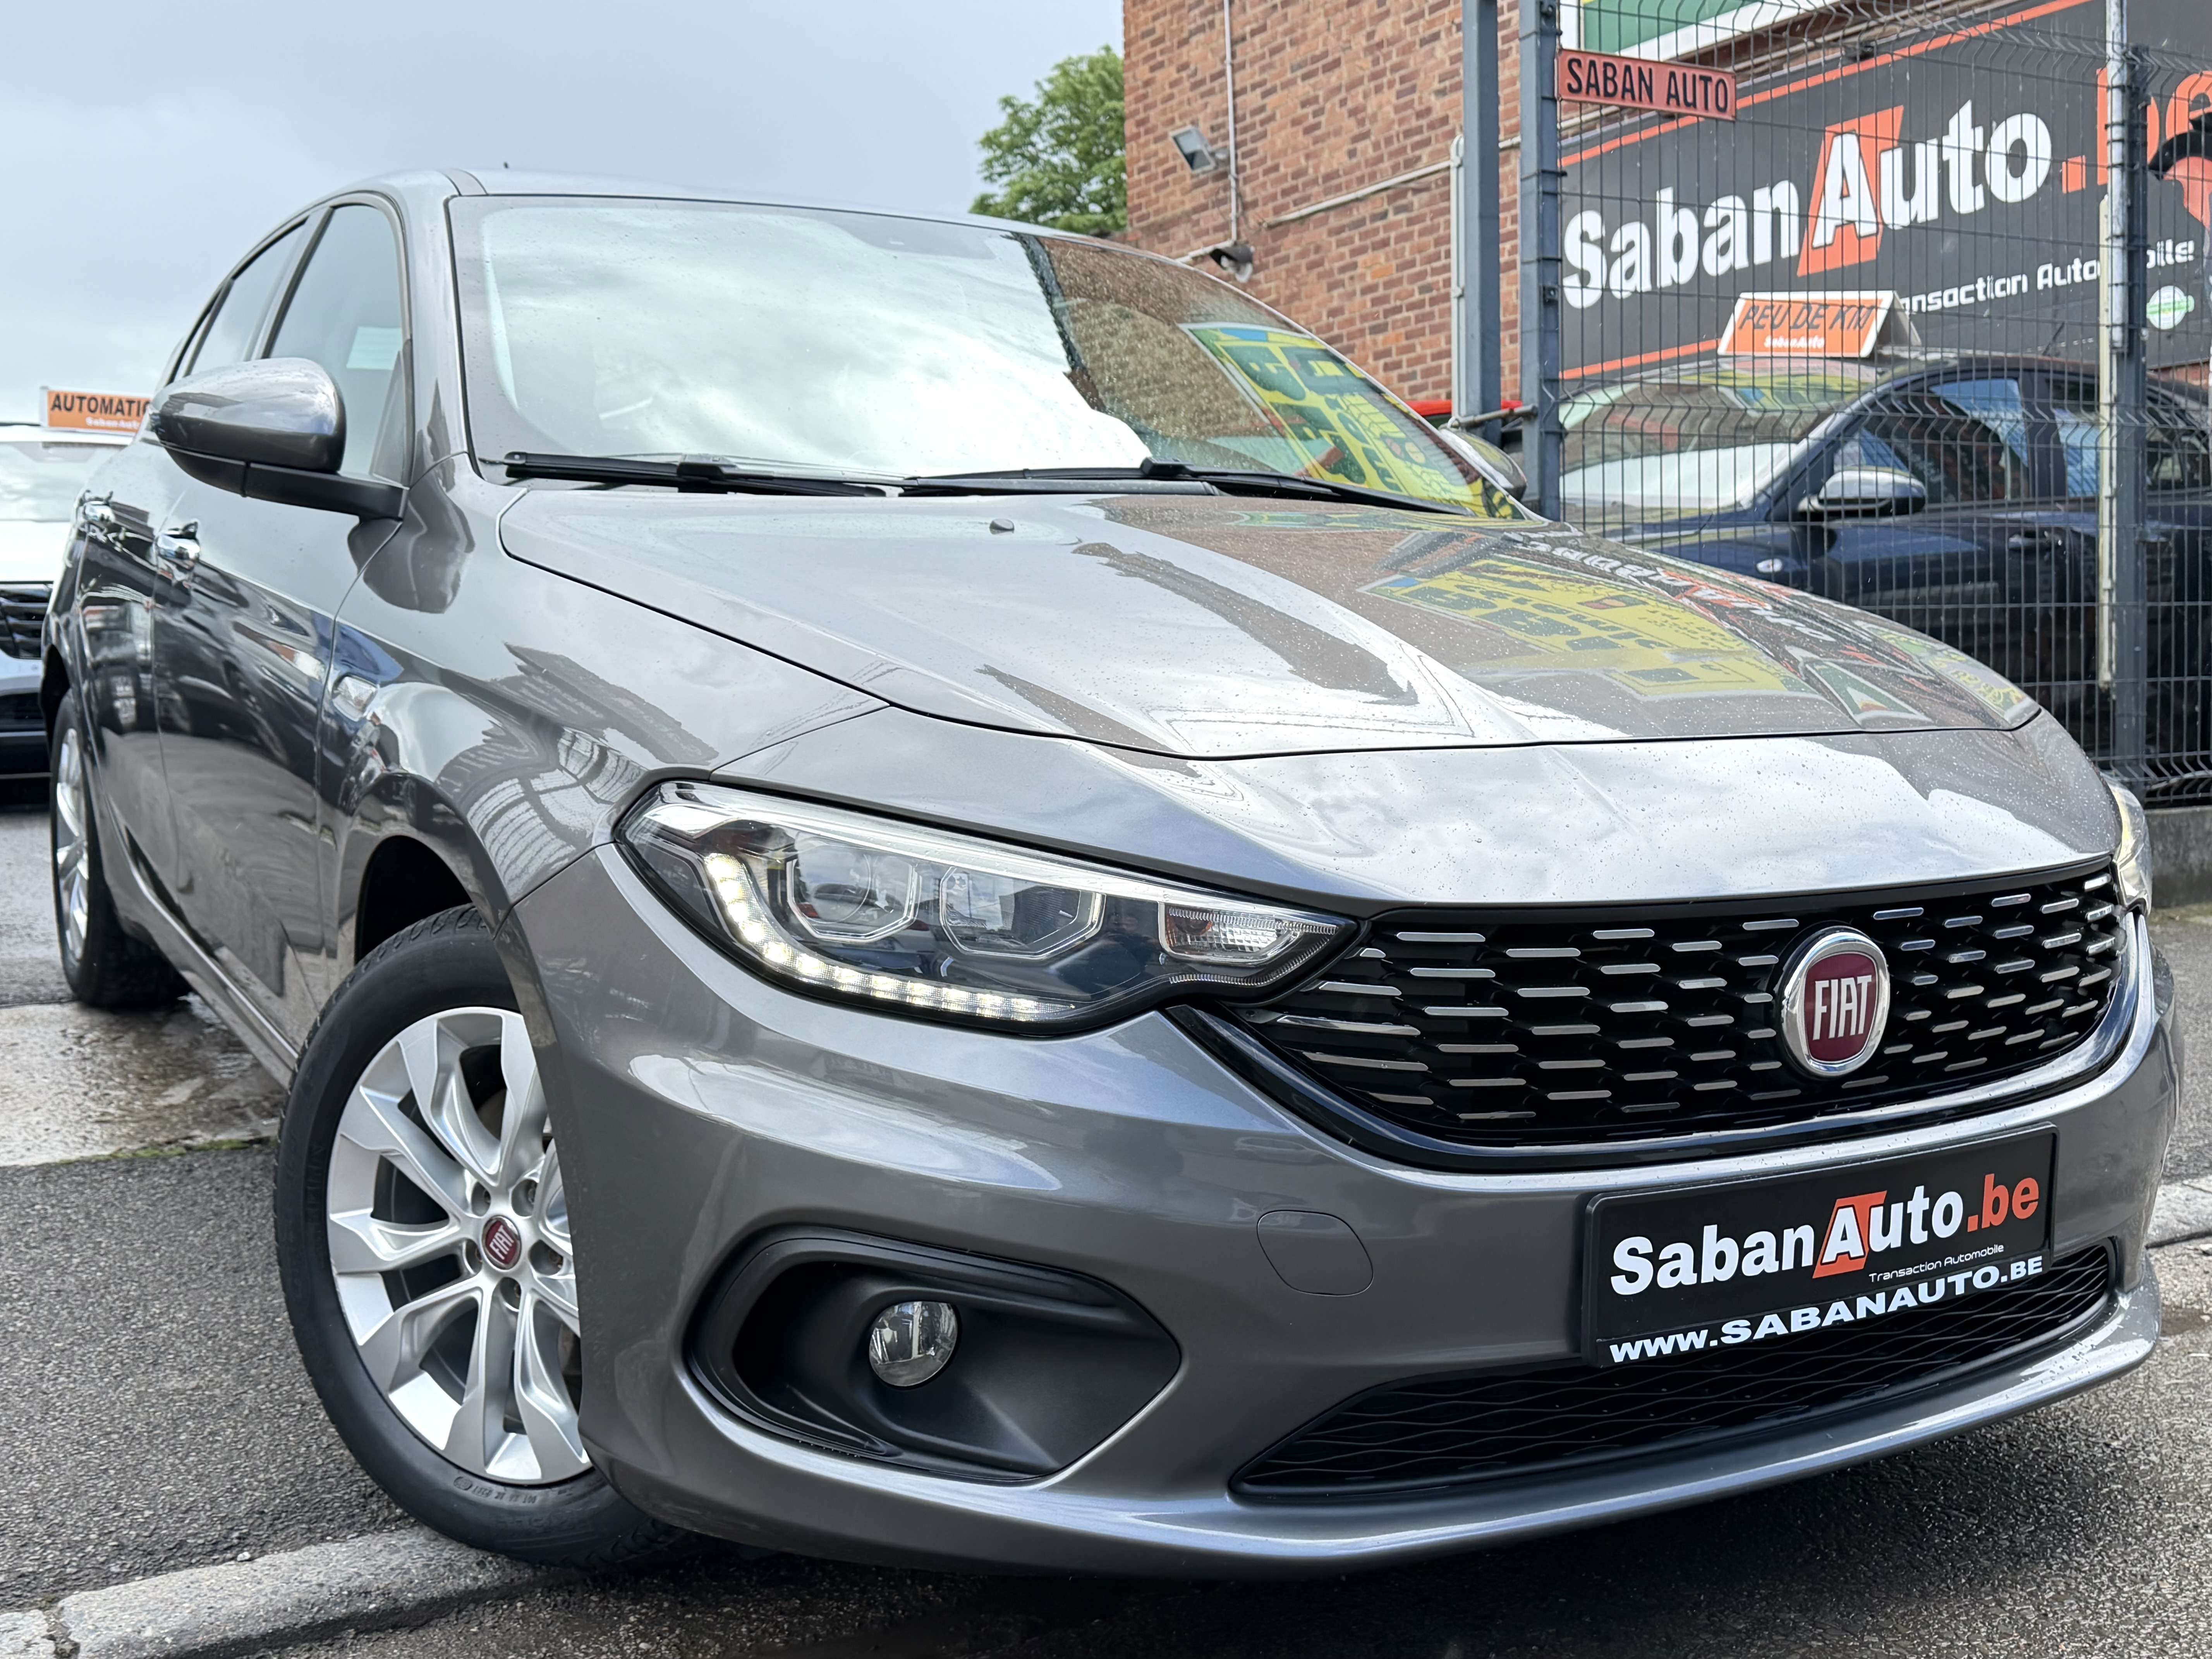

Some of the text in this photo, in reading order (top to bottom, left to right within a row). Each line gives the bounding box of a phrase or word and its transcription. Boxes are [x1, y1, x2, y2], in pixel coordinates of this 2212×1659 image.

[1567, 58, 1728, 113] SABAN AUTO
[1738, 303, 1876, 330] PEU DE KM
[1813, 975, 1872, 1041] FIAT
[489, 1224, 514, 1260] FIAT
[1611, 1173, 2039, 1295] SabanAuto.be
[1869, 1244, 2004, 1282] Transaction Automobile
